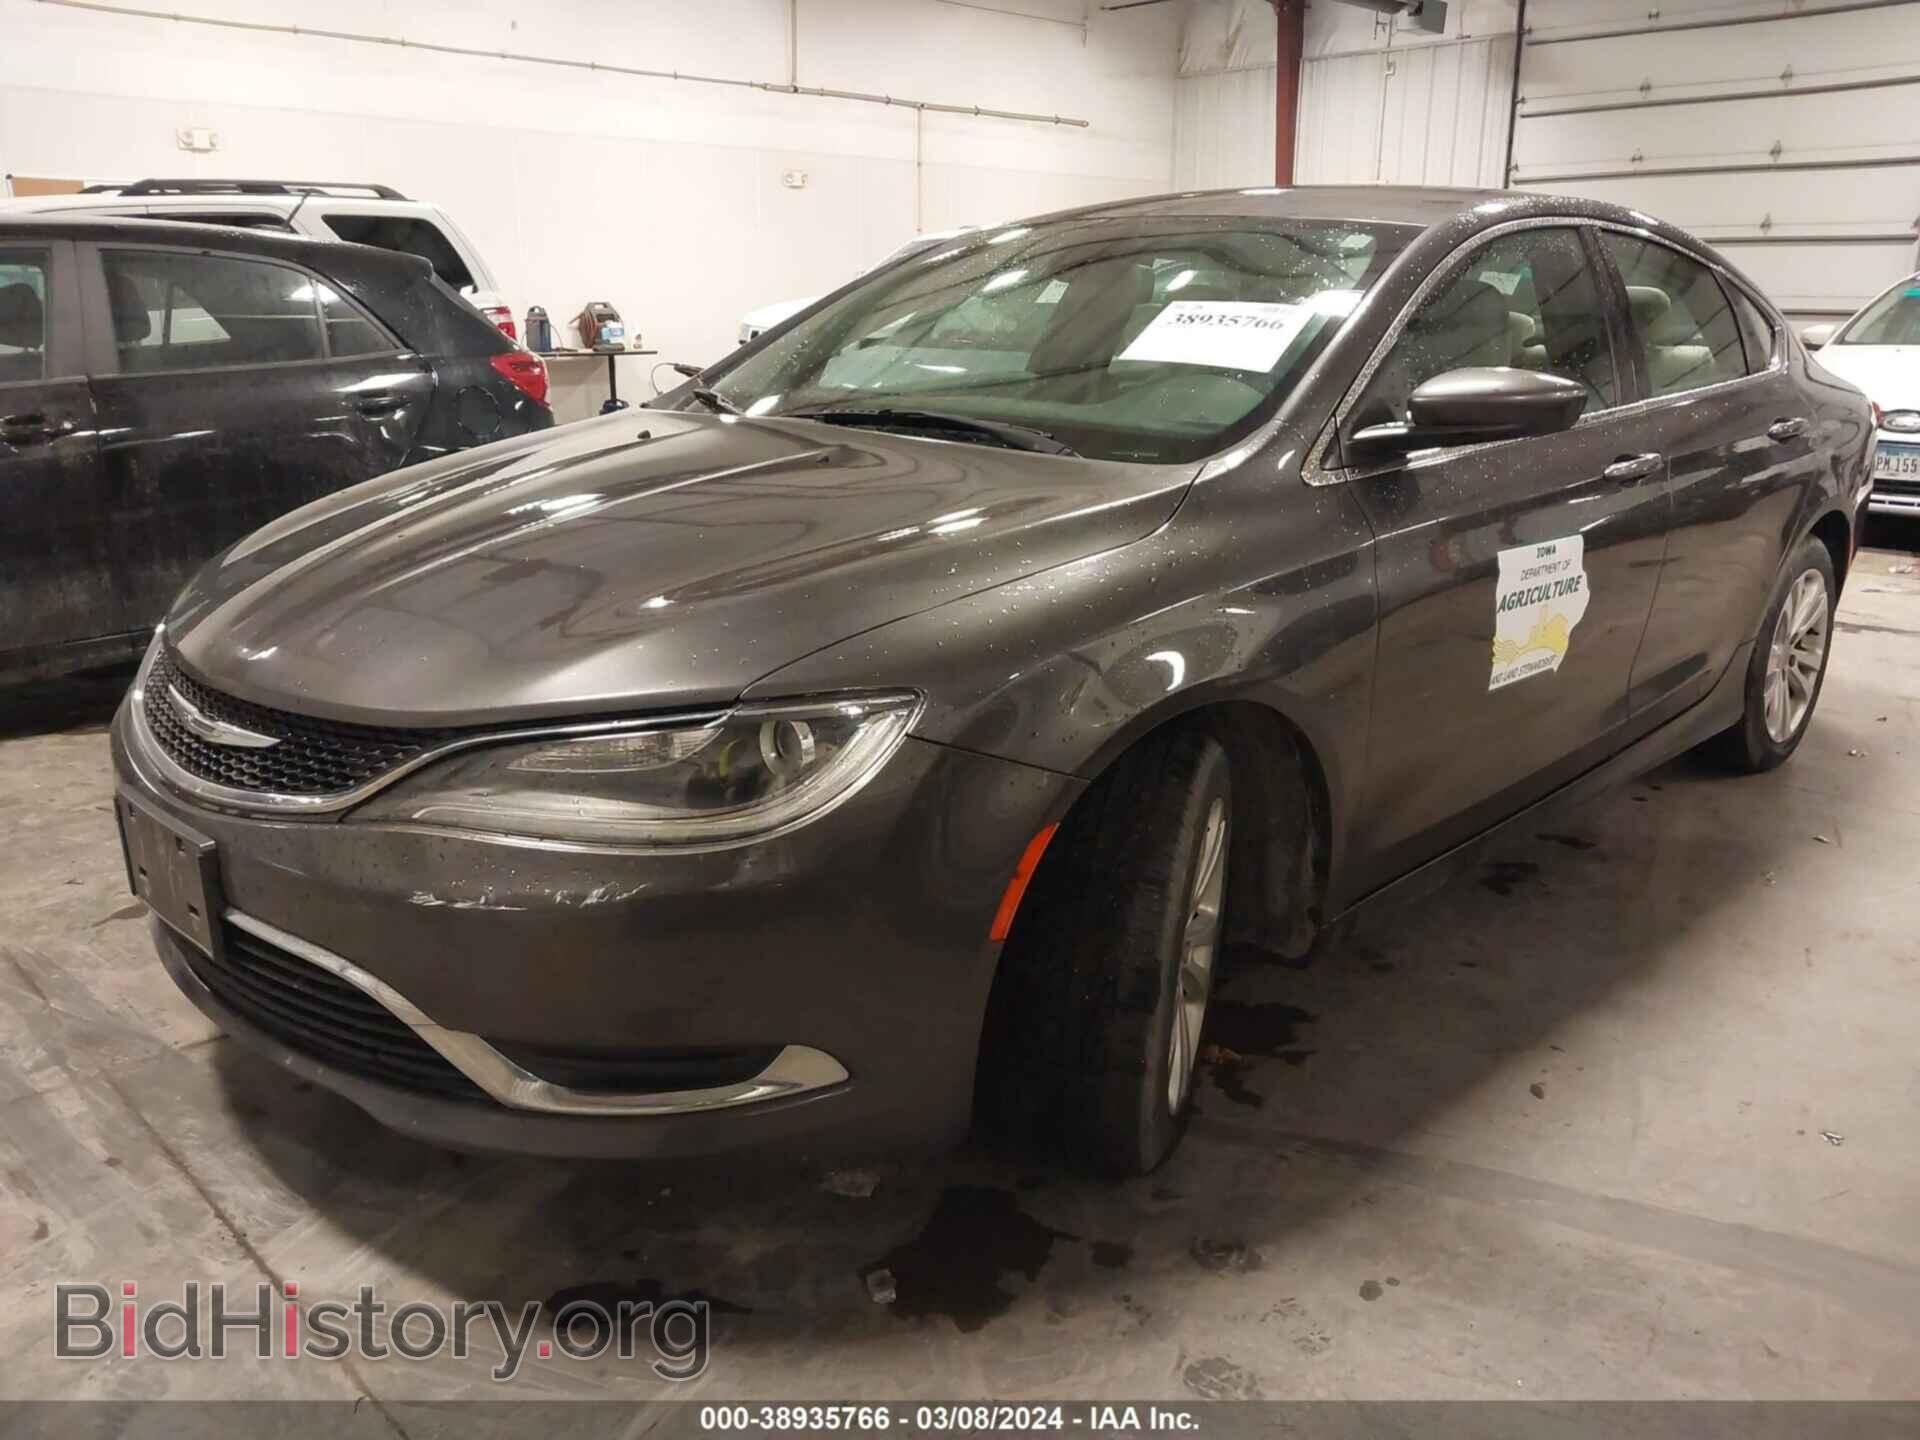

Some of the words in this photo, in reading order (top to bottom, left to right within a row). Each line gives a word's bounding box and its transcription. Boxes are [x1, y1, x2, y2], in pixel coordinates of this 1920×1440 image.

[1168, 313, 1285, 330] 38935766
[1537, 544, 1556, 558] IOWA
[1521, 561, 1561, 580] DEPARTMENT
[1497, 575, 1583, 614] AGRICULTURE
